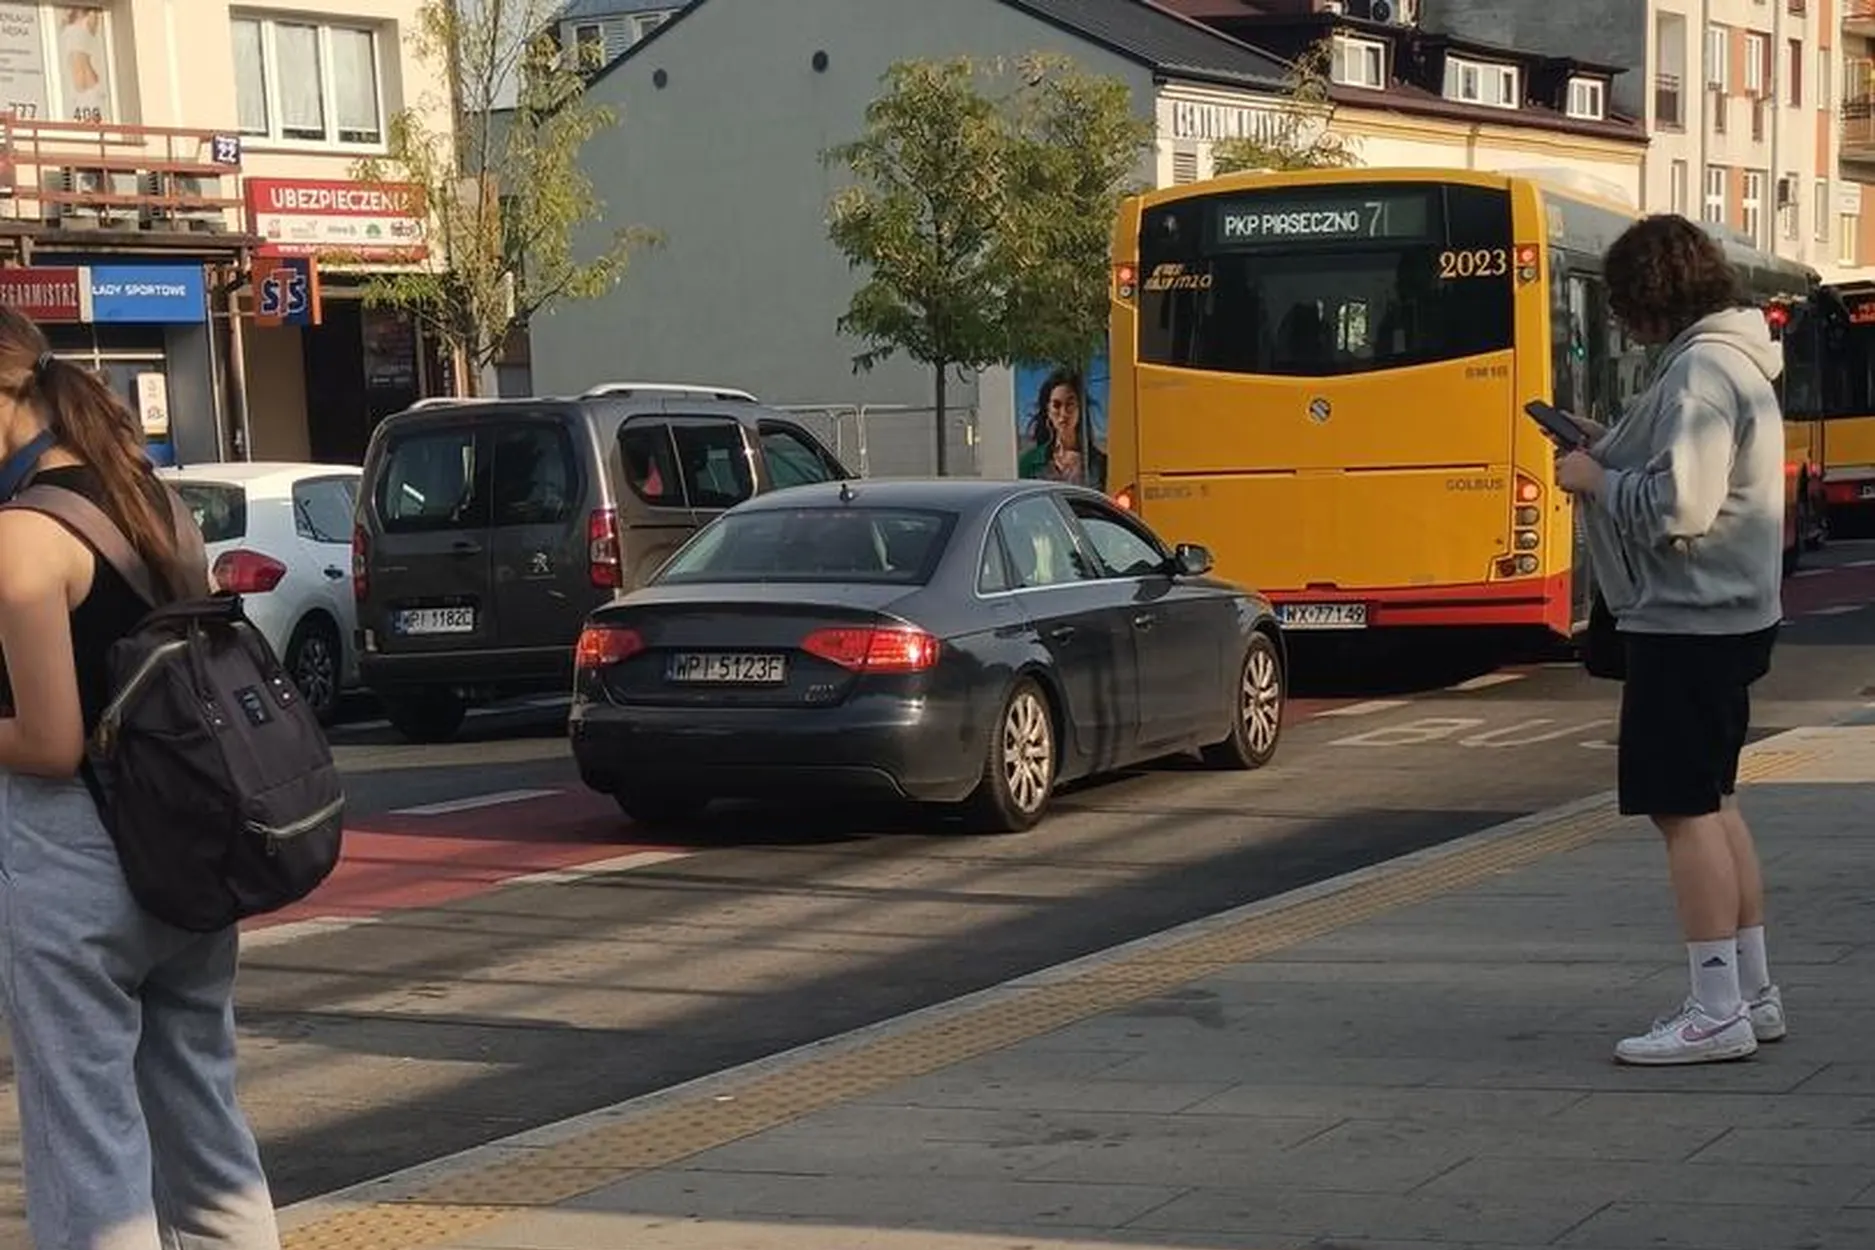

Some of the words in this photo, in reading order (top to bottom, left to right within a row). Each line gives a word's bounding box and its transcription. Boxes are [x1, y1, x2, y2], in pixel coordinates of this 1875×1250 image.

[1225, 215, 1259, 236] PKP
[1261, 210, 1360, 235] PIASECZNO
[1440, 249, 1507, 278] 2023
[124, 284, 186, 297] SPORTOWE
[261, 268, 307, 317] STS
[676, 655, 709, 679] WPI
[719, 655, 781, 679] 5123F
[1328, 719, 1619, 748] BU
